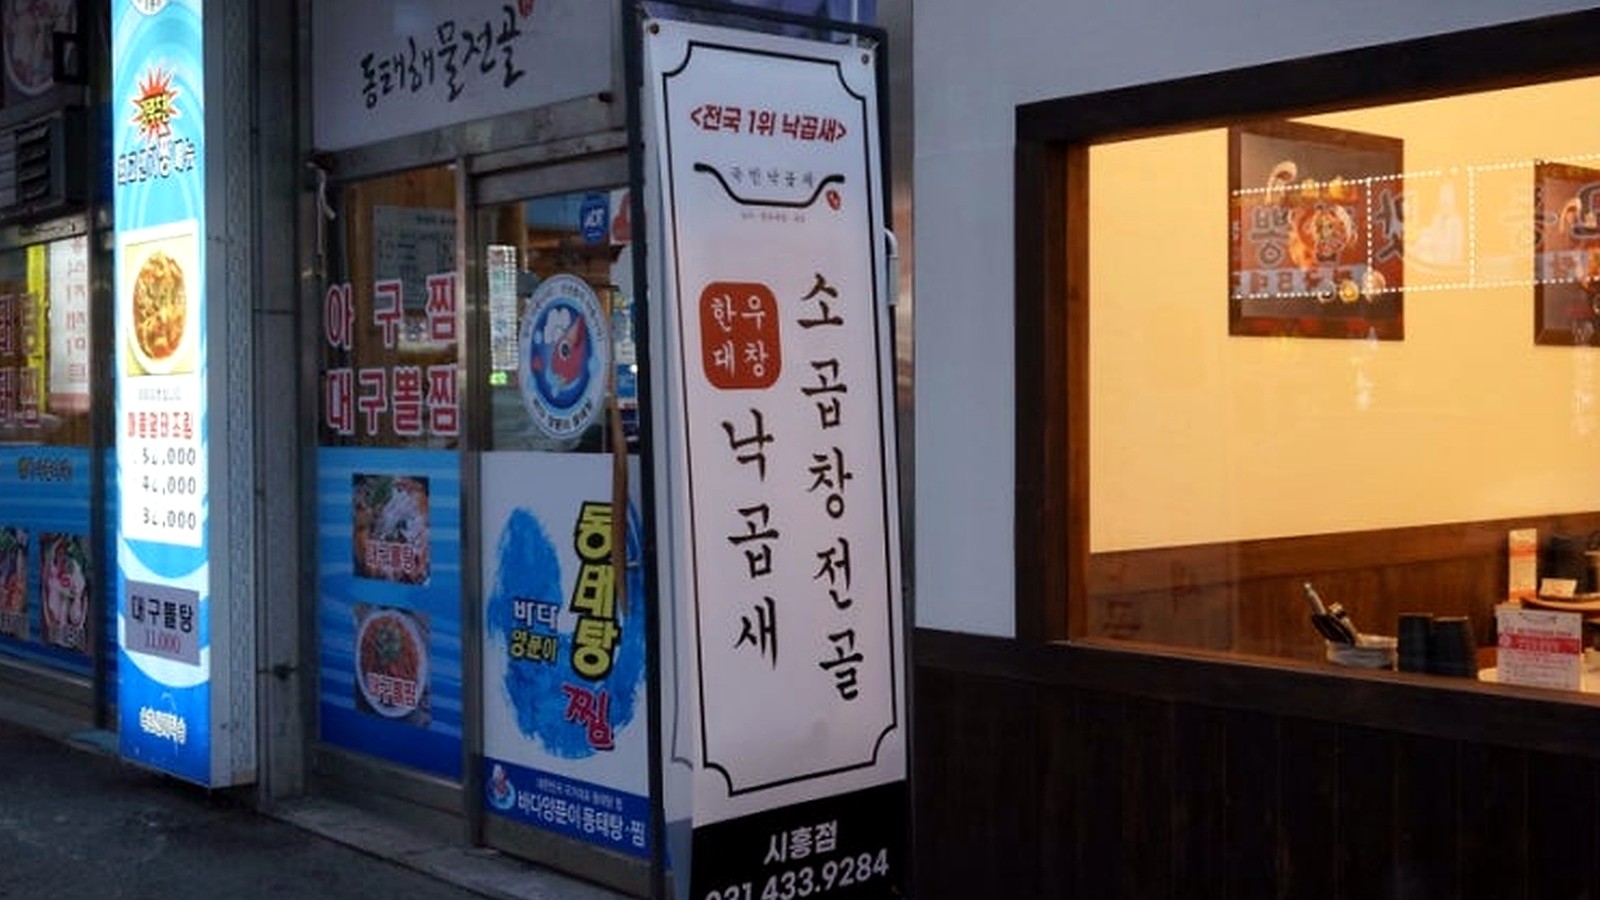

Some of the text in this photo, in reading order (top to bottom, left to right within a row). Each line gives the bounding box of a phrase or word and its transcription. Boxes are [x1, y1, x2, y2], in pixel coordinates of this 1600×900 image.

[360, 5, 526, 109] 동태해물전골
[748, 109, 776, 137] 1위
[711, 295, 767, 333] 한우
[711, 341, 770, 378] 대창
[326, 364, 458, 436] 대구뽈찜
[796, 273, 864, 702] 소곱창전골
[722, 408, 780, 670] 낙곱새
[131, 595, 194, 633] 대구뽈탕
[513, 598, 558, 632] 바다
[570, 501, 621, 681] 동태탕
[562, 682, 615, 751] 찜
[763, 820, 838, 865] 시흥점
